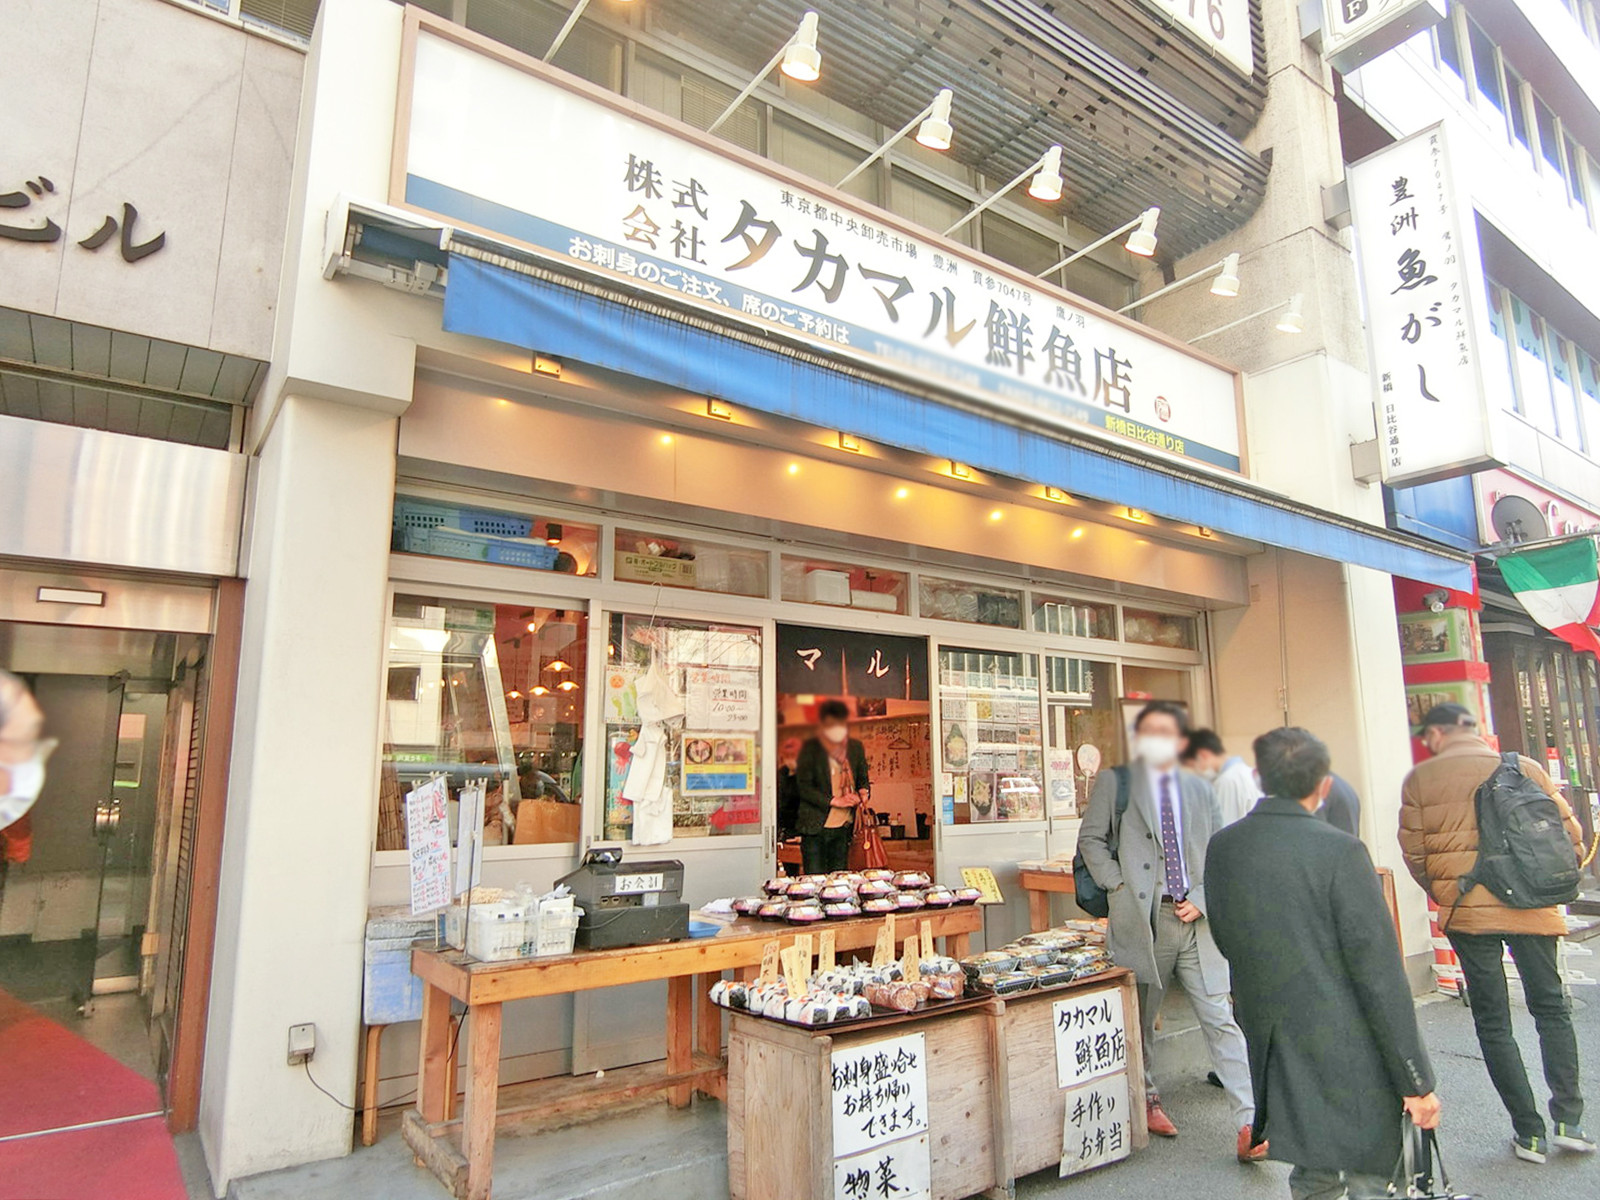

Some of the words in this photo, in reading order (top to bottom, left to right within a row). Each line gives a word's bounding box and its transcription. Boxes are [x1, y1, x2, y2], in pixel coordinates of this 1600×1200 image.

[0, 176, 165, 263] ビル
[780, 189, 918, 260] 東京都中央卸売市場
[719, 199, 1133, 414] タカマル鮮魚店
[1105, 414, 1186, 455] 新橋日比谷通り店
[1386, 404, 1401, 467] 日比谷通り店
[620, 876, 658, 891] お会計
[1058, 998, 1113, 1033] タカマル
[1075, 1027, 1125, 1077] 鮮魚店
[843, 1079, 911, 1117] お持ち帰り
[1071, 1091, 1116, 1128] 手作り
[1080, 1122, 1122, 1160] お弁当
